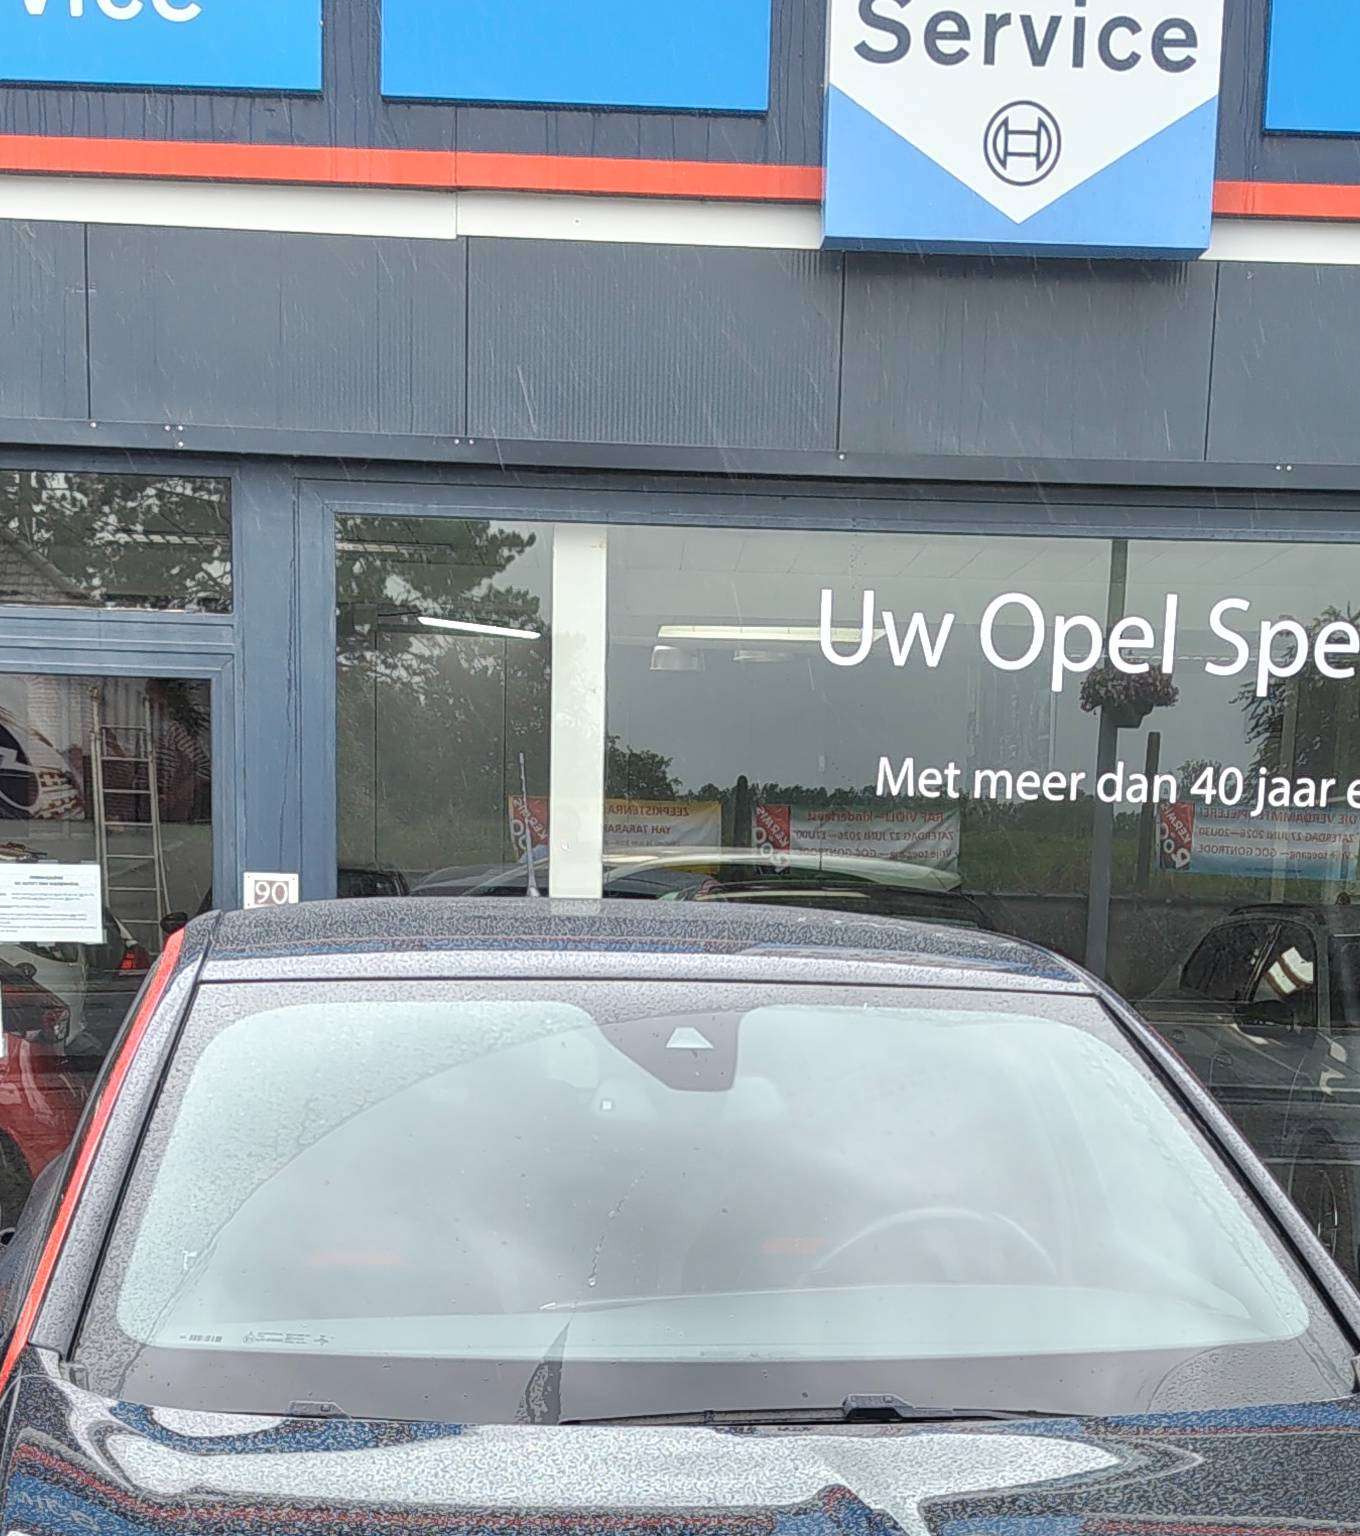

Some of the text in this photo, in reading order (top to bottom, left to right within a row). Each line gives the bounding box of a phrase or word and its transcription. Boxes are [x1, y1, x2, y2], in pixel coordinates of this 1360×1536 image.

[853, 0, 1198, 73] Service
[818, 587, 956, 668] Uw
[979, 591, 1179, 693] Opel
[875, 755, 961, 800] Met
[973, 768, 1087, 802] meer
[1096, 760, 1178, 805] dan
[1190, 765, 1244, 807] 40
[1249, 766, 1337, 818] jaar
[255, 881, 288, 905] 90
